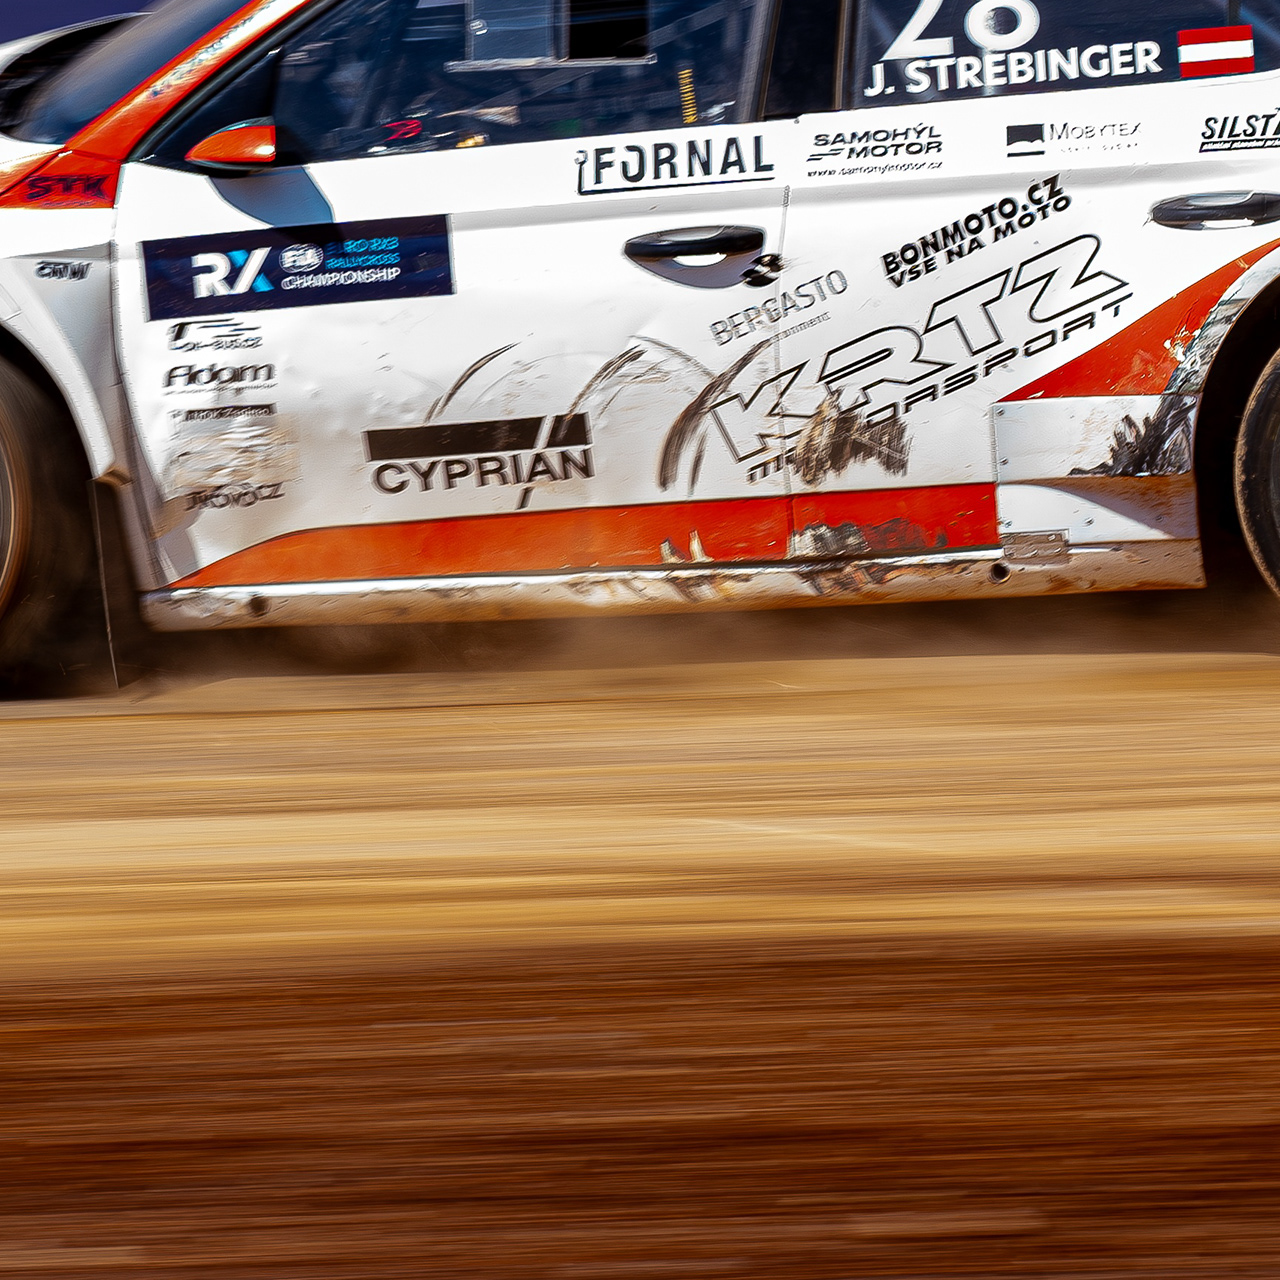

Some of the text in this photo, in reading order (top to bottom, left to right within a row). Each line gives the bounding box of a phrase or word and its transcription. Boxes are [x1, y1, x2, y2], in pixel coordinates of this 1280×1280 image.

[863, 41, 1164, 97] J. STREBINGER
[813, 122, 942, 147] SAMOHÝL
[847, 141, 943, 159] MOTOR
[880, 173, 1064, 276] BONMOTO.CZ
[887, 195, 1072, 288] VSE NA MOTO
[191, 246, 274, 299] RX
[281, 267, 402, 290] CHAMPIONSHIP
[710, 269, 848, 346] BERGASTO
[371, 449, 596, 495] CYPRIAN
